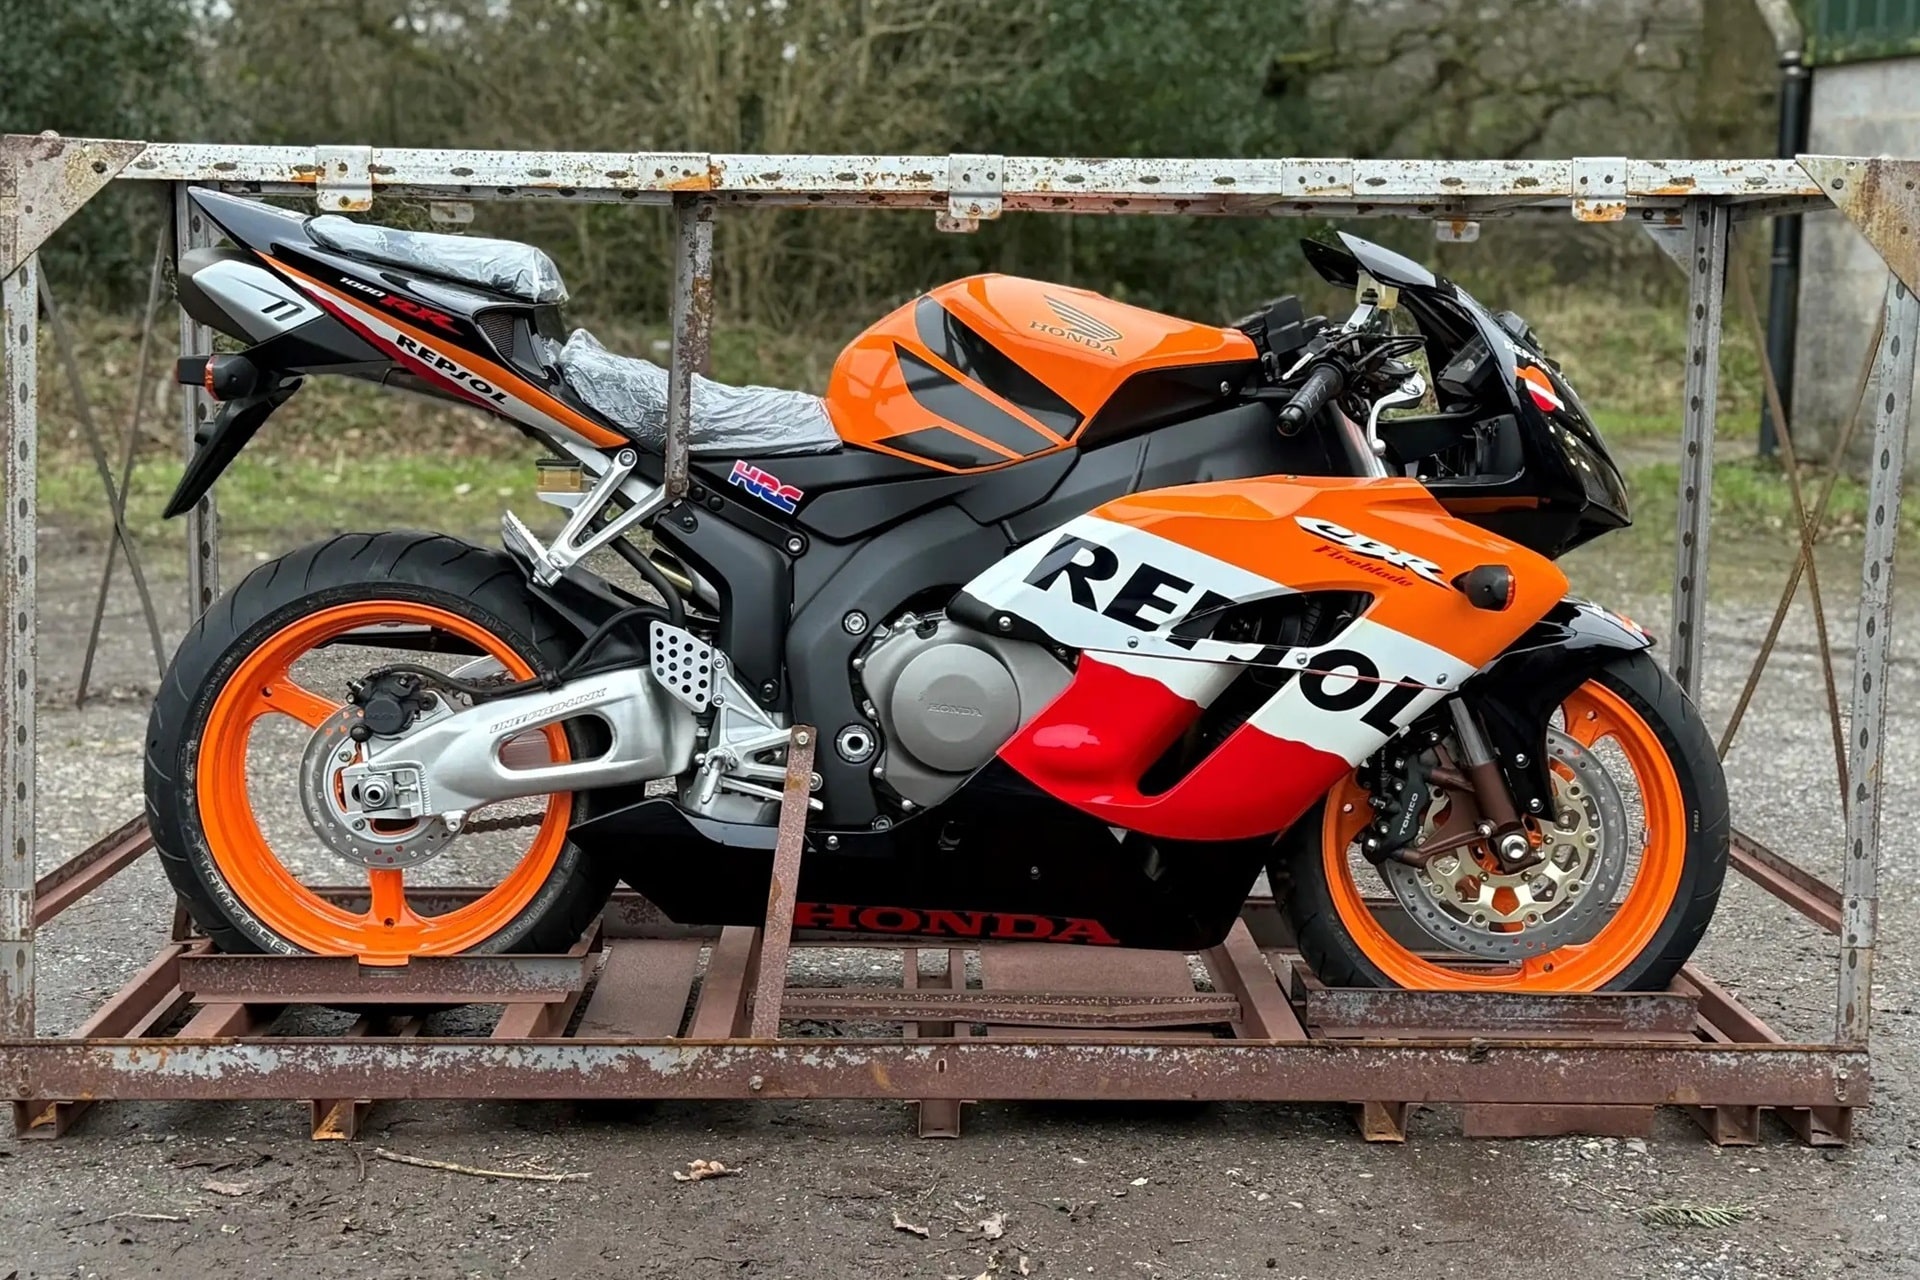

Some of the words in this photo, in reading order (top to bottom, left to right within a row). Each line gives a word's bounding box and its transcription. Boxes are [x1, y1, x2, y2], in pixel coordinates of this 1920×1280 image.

[1029, 321, 1118, 357] HONDA
[395, 334, 508, 405] REPSOL
[728, 459, 804, 515] HRC
[1294, 515, 1453, 592] CBR
[1313, 545, 1414, 587] Fireblade
[927, 702, 983, 718] HONDA
[1399, 792, 1419, 836] TOKICO
[793, 901, 1121, 945] HONDA
